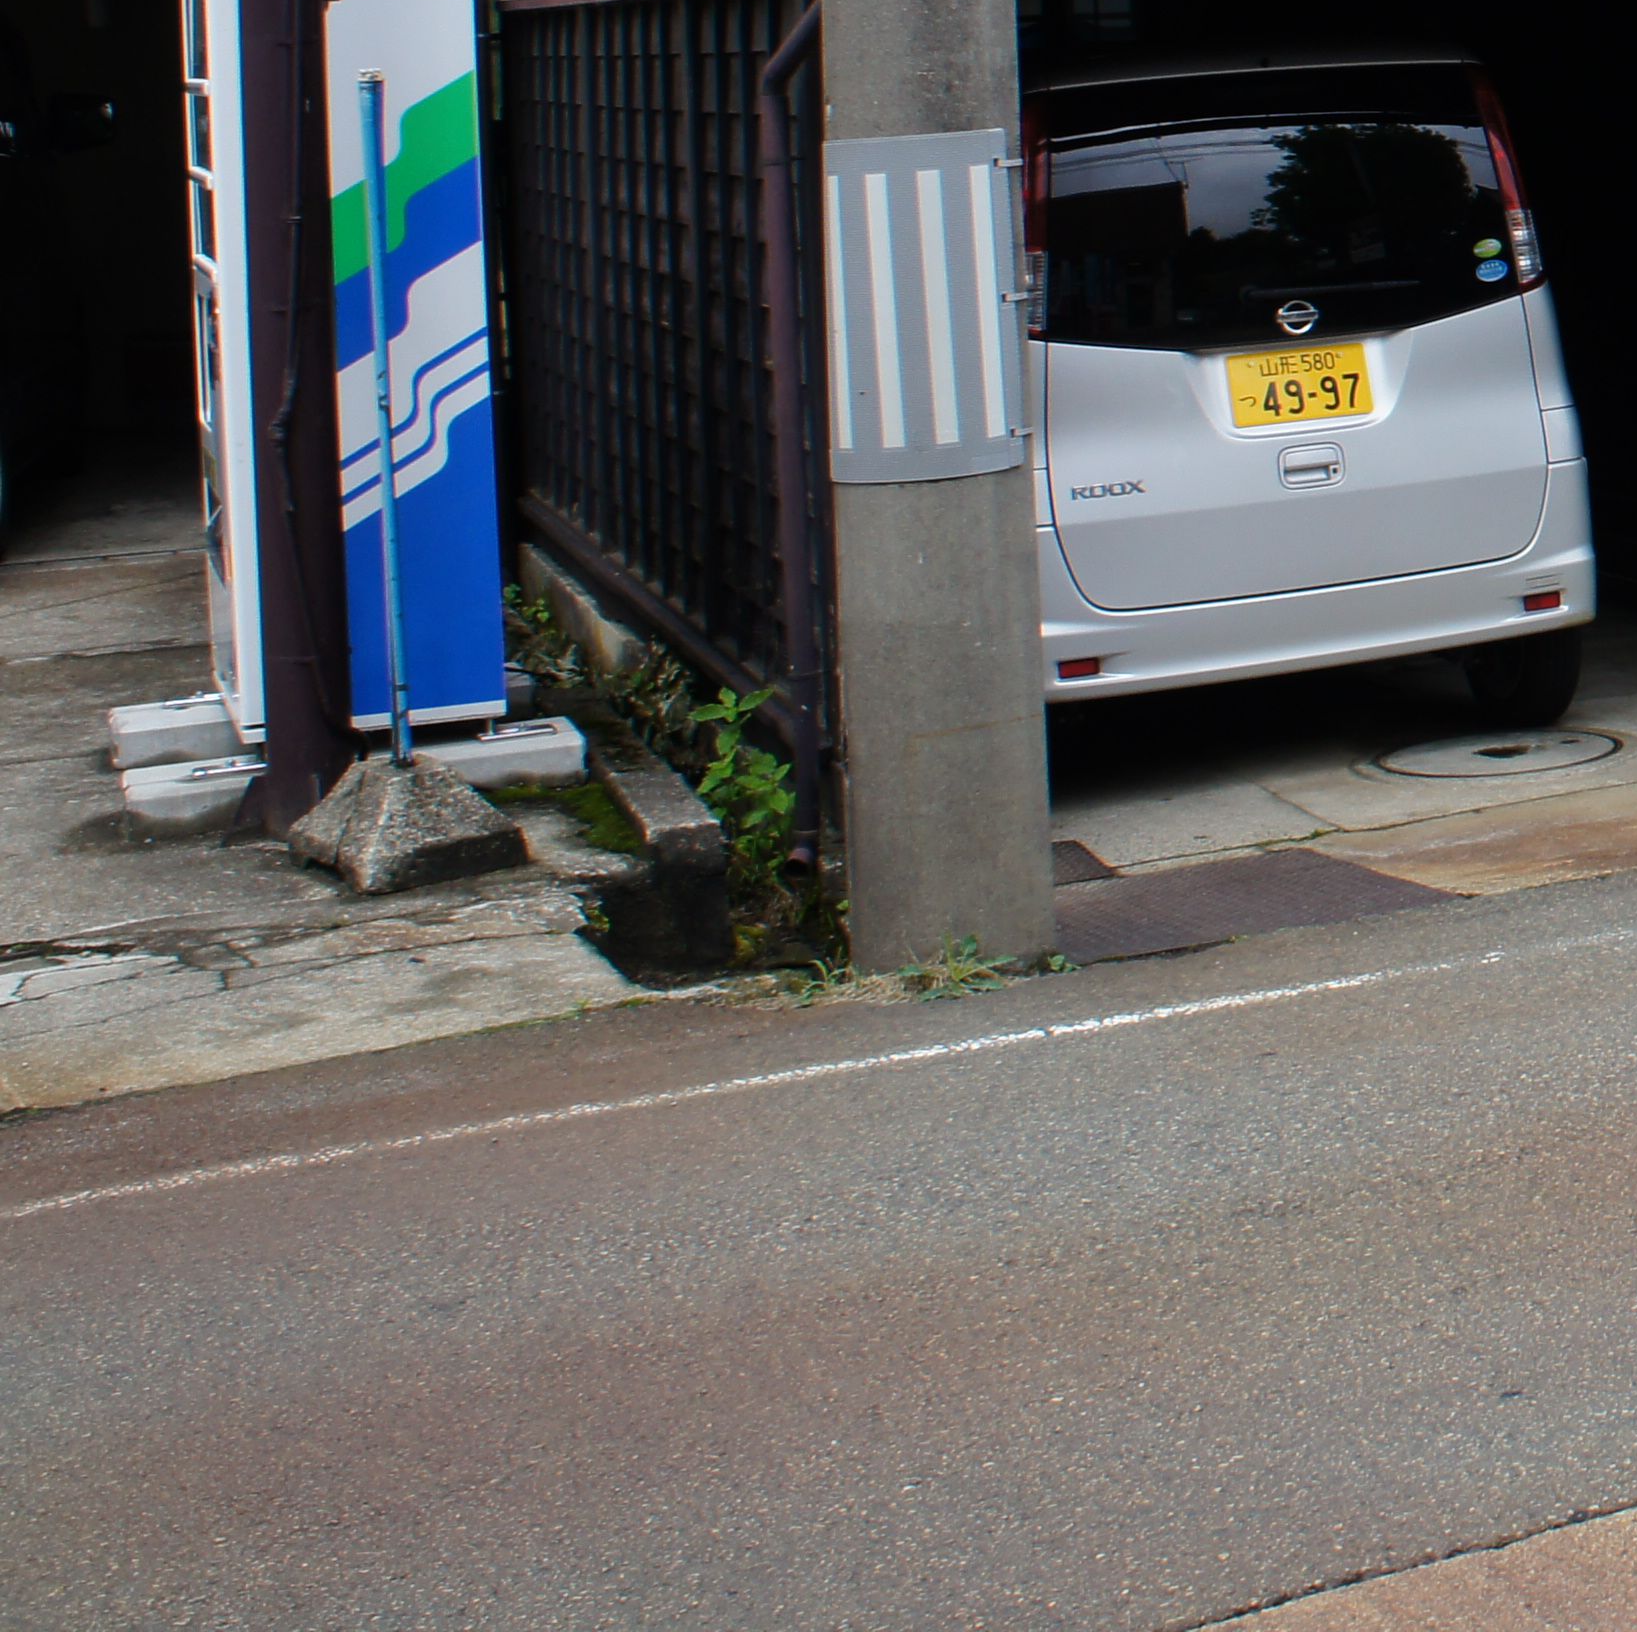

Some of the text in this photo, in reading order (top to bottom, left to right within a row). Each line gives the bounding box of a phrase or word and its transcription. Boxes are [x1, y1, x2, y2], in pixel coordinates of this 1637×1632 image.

[1258, 352, 1336, 377] 山形 580
[1238, 373, 1361, 417] つ 49-97
[1071, 480, 1147, 501] ROOX
